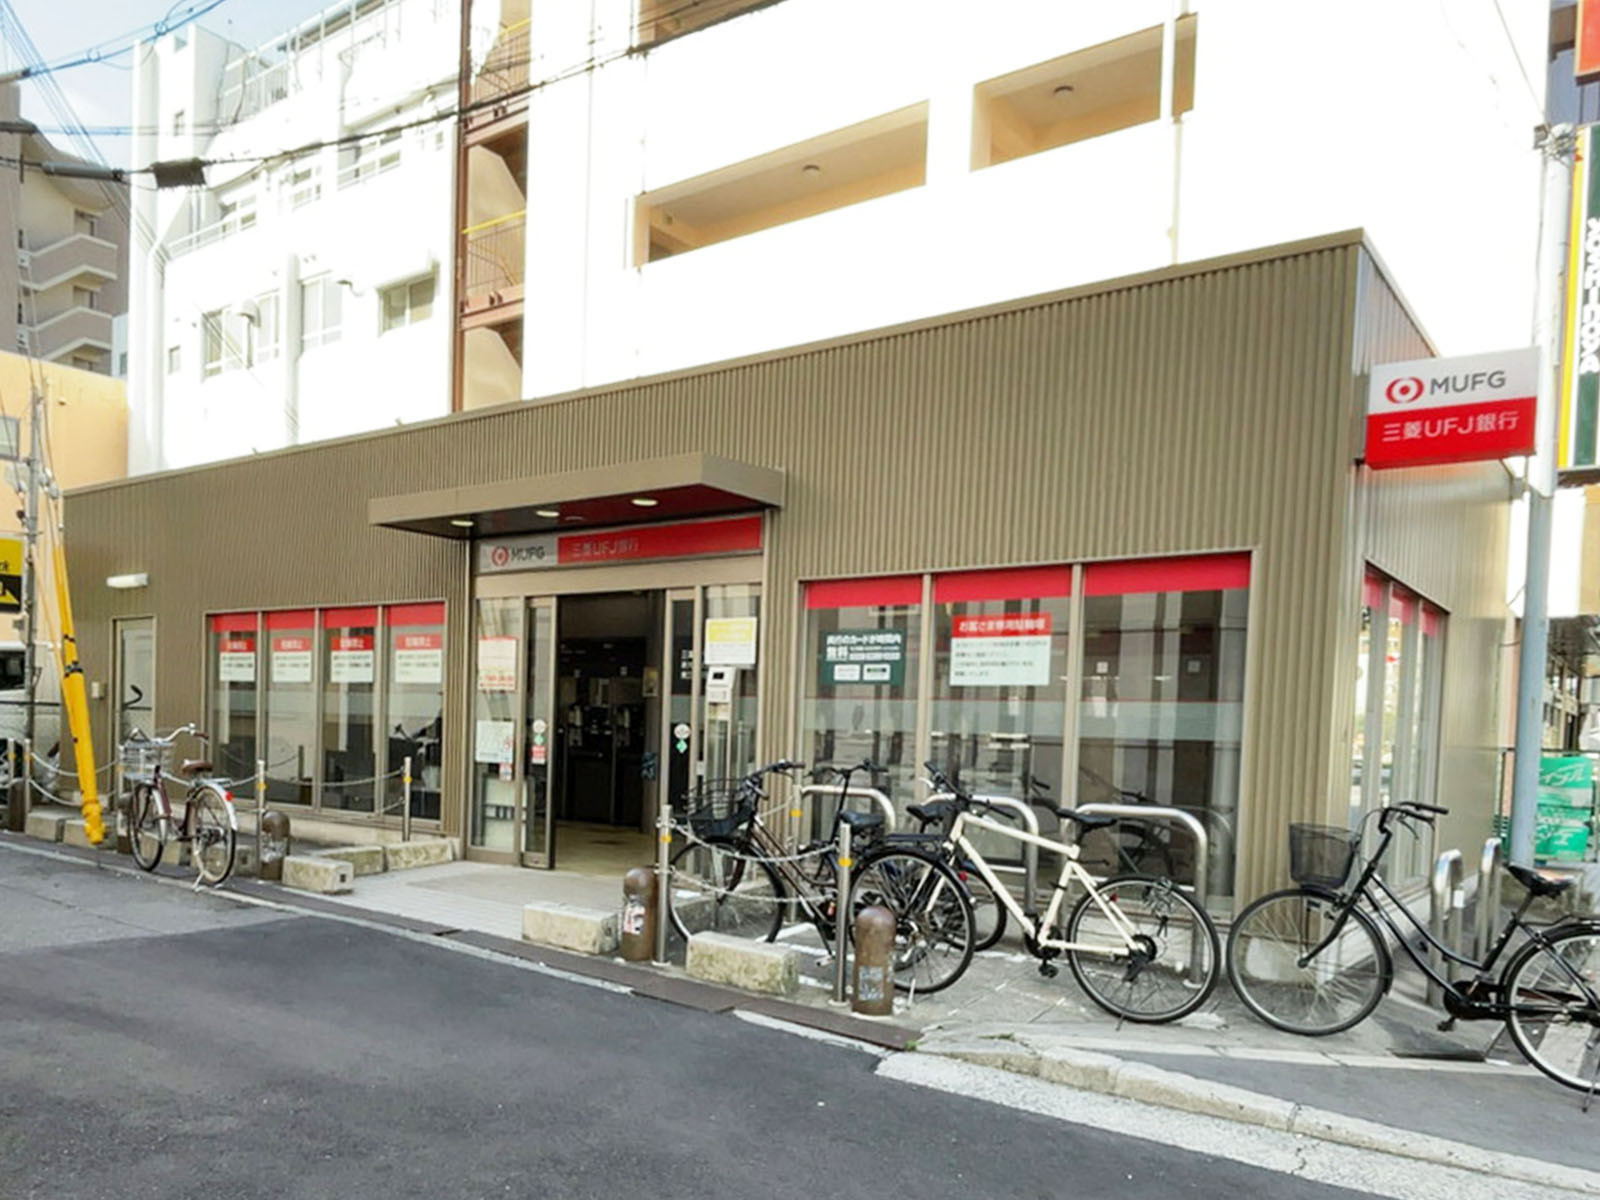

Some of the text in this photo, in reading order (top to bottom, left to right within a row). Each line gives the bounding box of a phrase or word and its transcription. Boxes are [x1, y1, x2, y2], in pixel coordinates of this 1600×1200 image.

[1430, 371, 1507, 395] MUFG
[1382, 411, 1520, 442] 三菱UFJ銀行
[511, 546, 546, 561] MUFG
